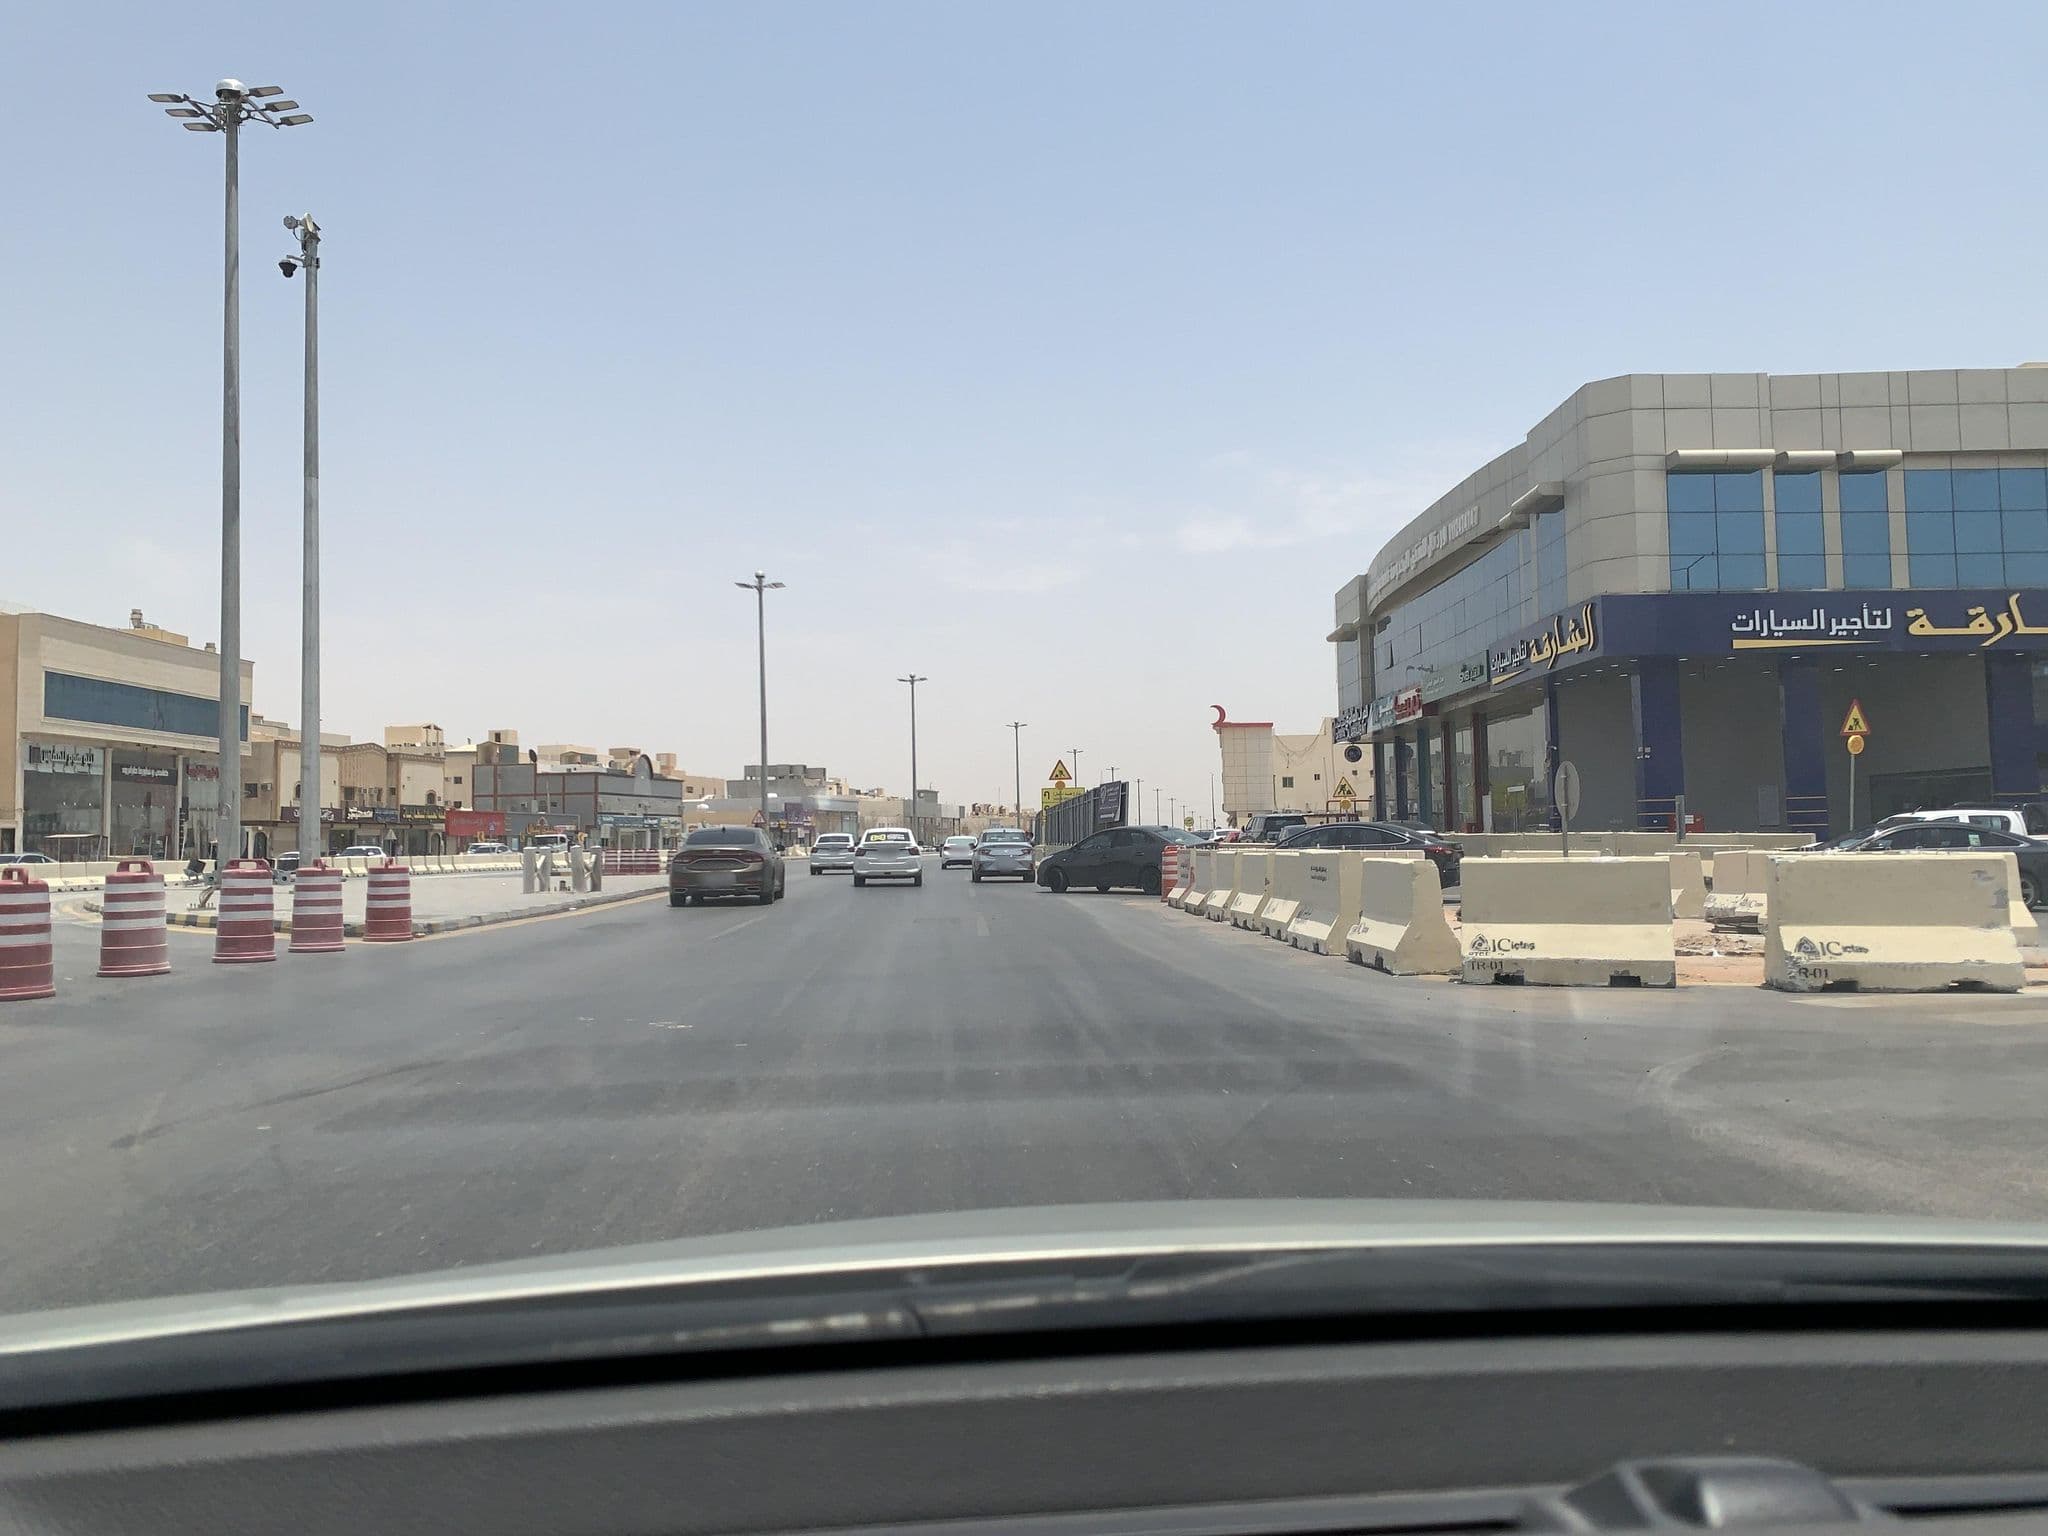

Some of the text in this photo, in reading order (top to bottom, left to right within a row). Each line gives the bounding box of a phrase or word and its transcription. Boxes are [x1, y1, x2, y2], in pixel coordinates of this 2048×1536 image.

[1529, 603, 1595, 670] الشارقة
[1731, 592, 2048, 647] ارقة لتأجير السيارات
